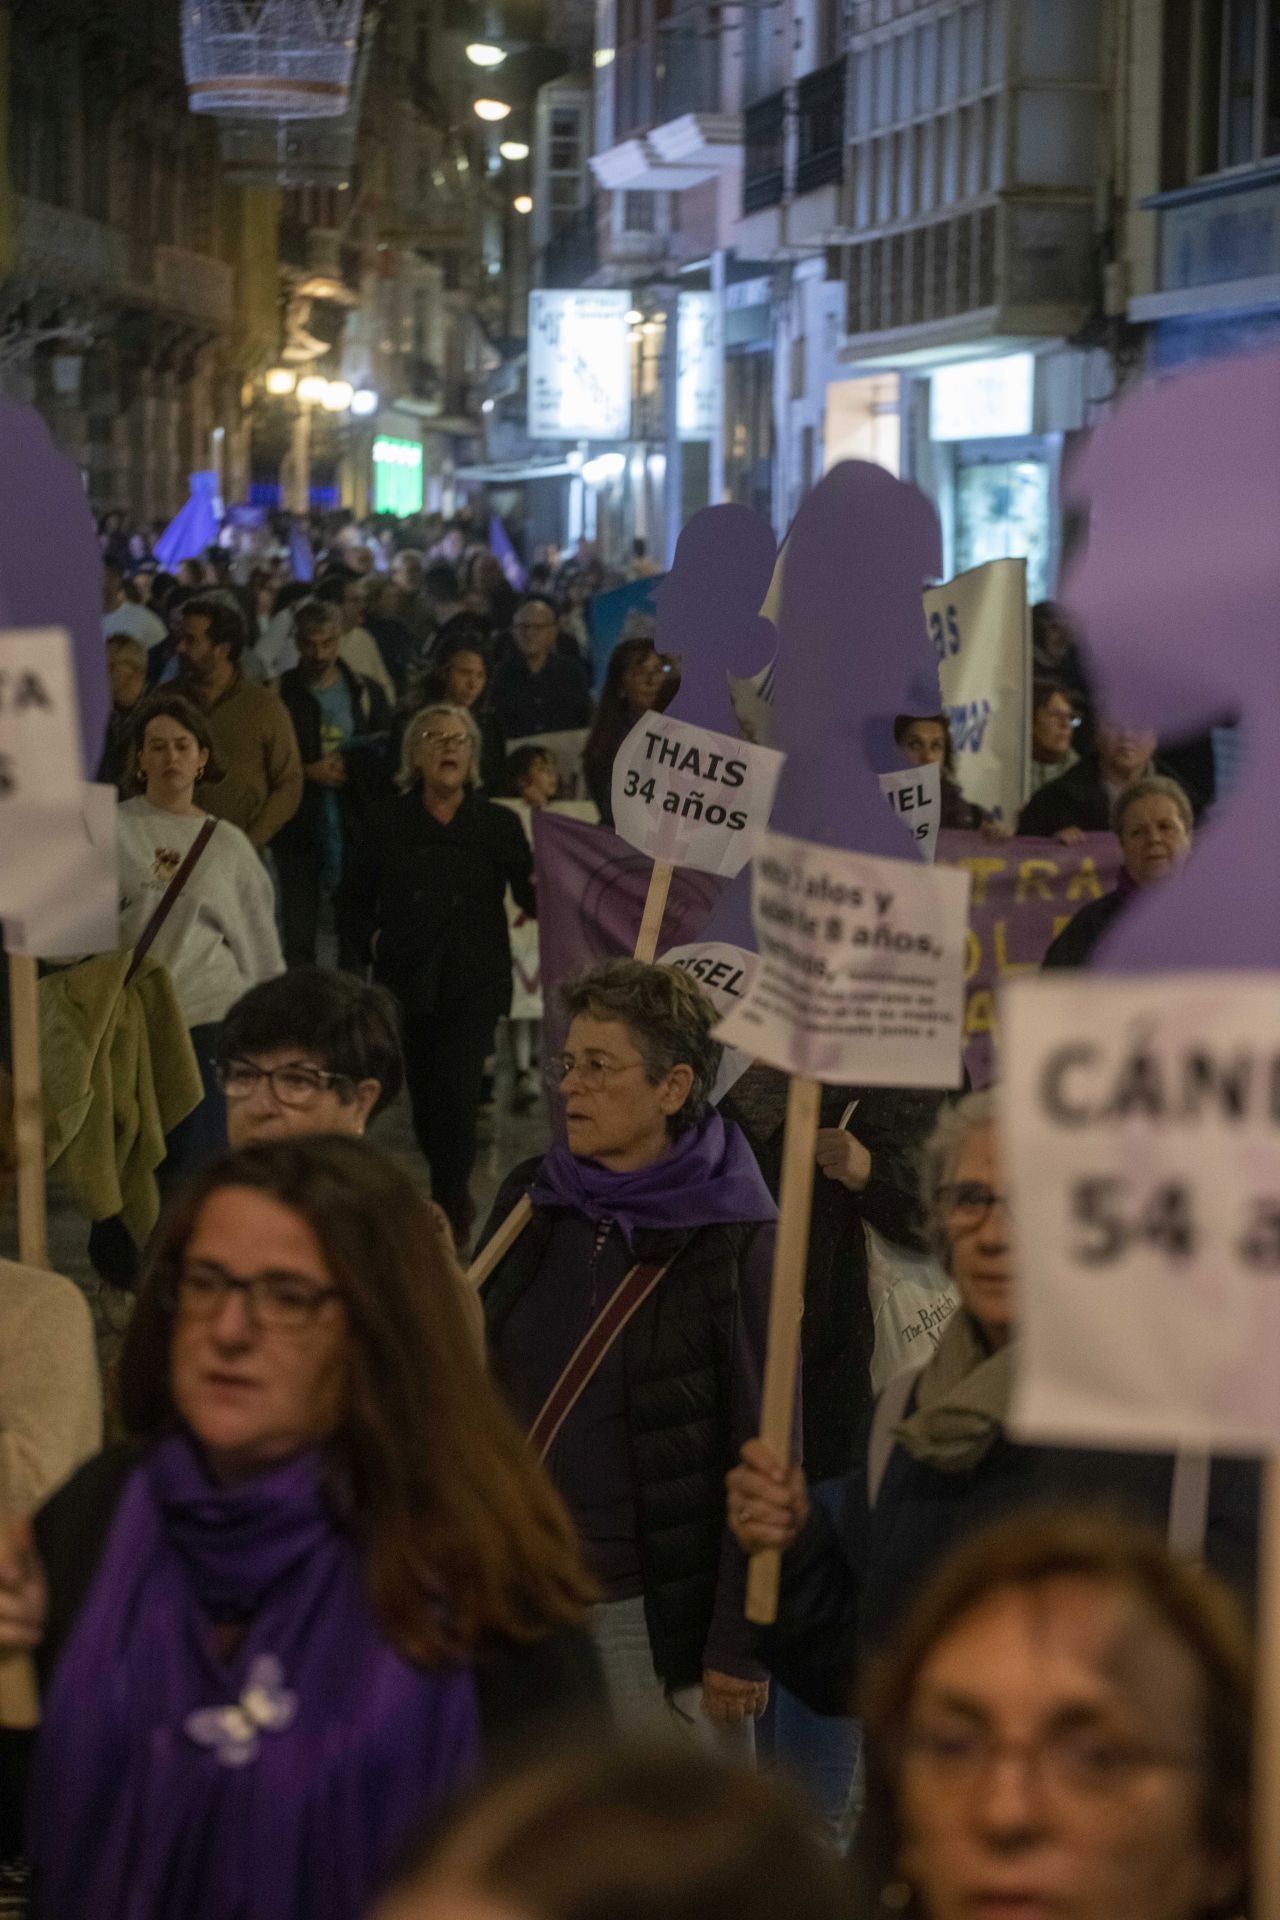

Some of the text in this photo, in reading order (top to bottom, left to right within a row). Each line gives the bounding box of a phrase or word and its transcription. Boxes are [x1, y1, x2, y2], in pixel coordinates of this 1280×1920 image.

[644, 730, 748, 788] THAIS
[623, 769, 749, 831] 34 años
[1038, 1012, 1280, 1130] CÁN
[1070, 1174, 1197, 1270] 54
